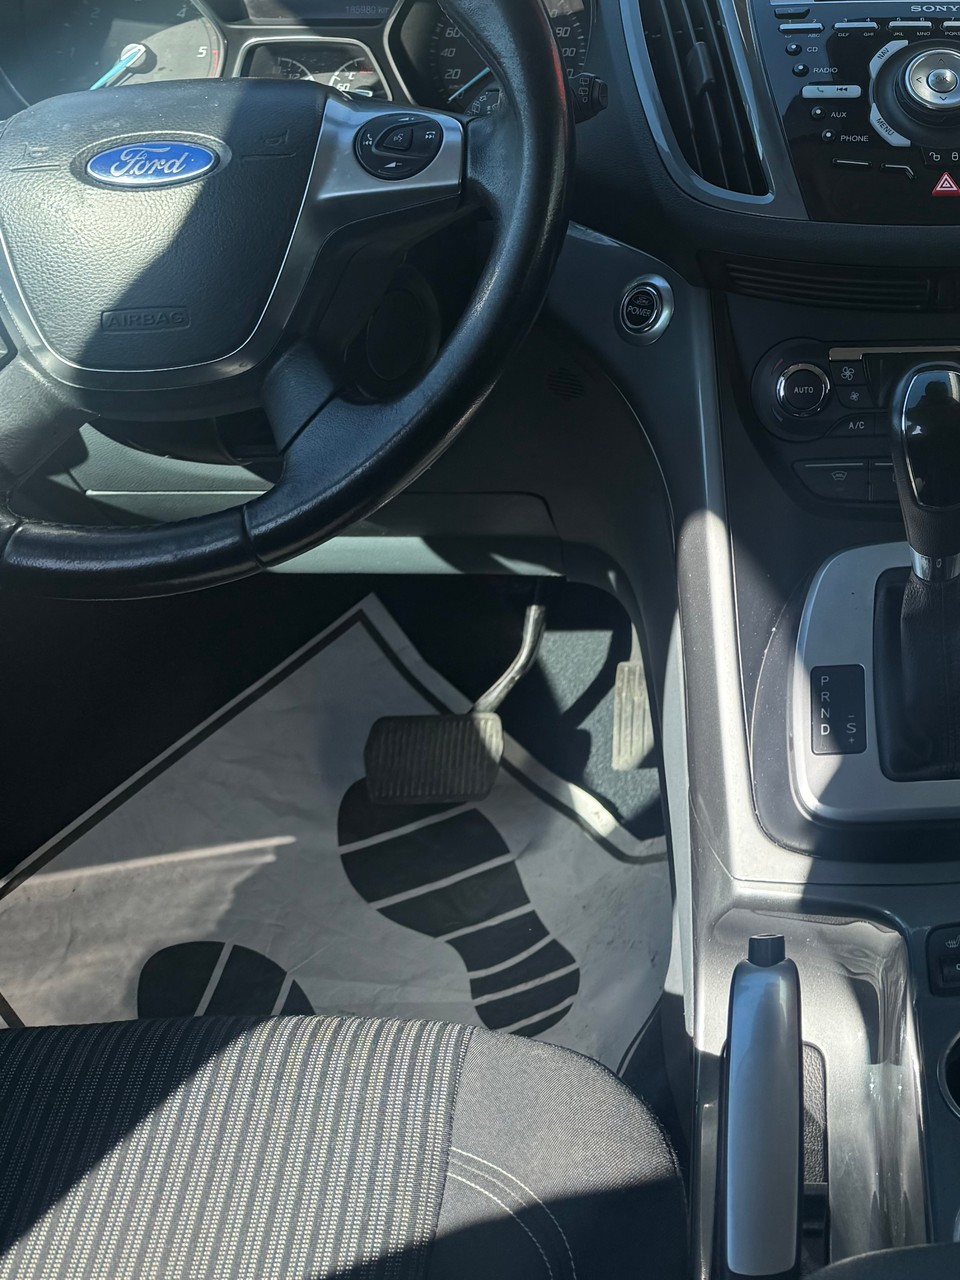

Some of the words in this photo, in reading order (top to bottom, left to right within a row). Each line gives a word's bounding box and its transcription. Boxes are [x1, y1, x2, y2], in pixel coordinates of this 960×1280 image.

[196, 46, 208, 58] 5
[877, 47, 890, 60] NAV
[444, 68, 462, 80] 20
[813, 66, 839, 74] RADIO
[875, 118, 895, 137] MENU
[110, 147, 190, 177] Ford
[627, 305, 652, 317] POWER
[106, 311, 186, 329] AIRBAG
[793, 386, 814, 394] AUTO
[848, 421, 865, 429] A/C
[821, 675, 830, 686] P
[821, 691, 830, 702] R
[820, 707, 830, 719] N
[820, 723, 831, 736] D
[846, 722, 857, 734] S
